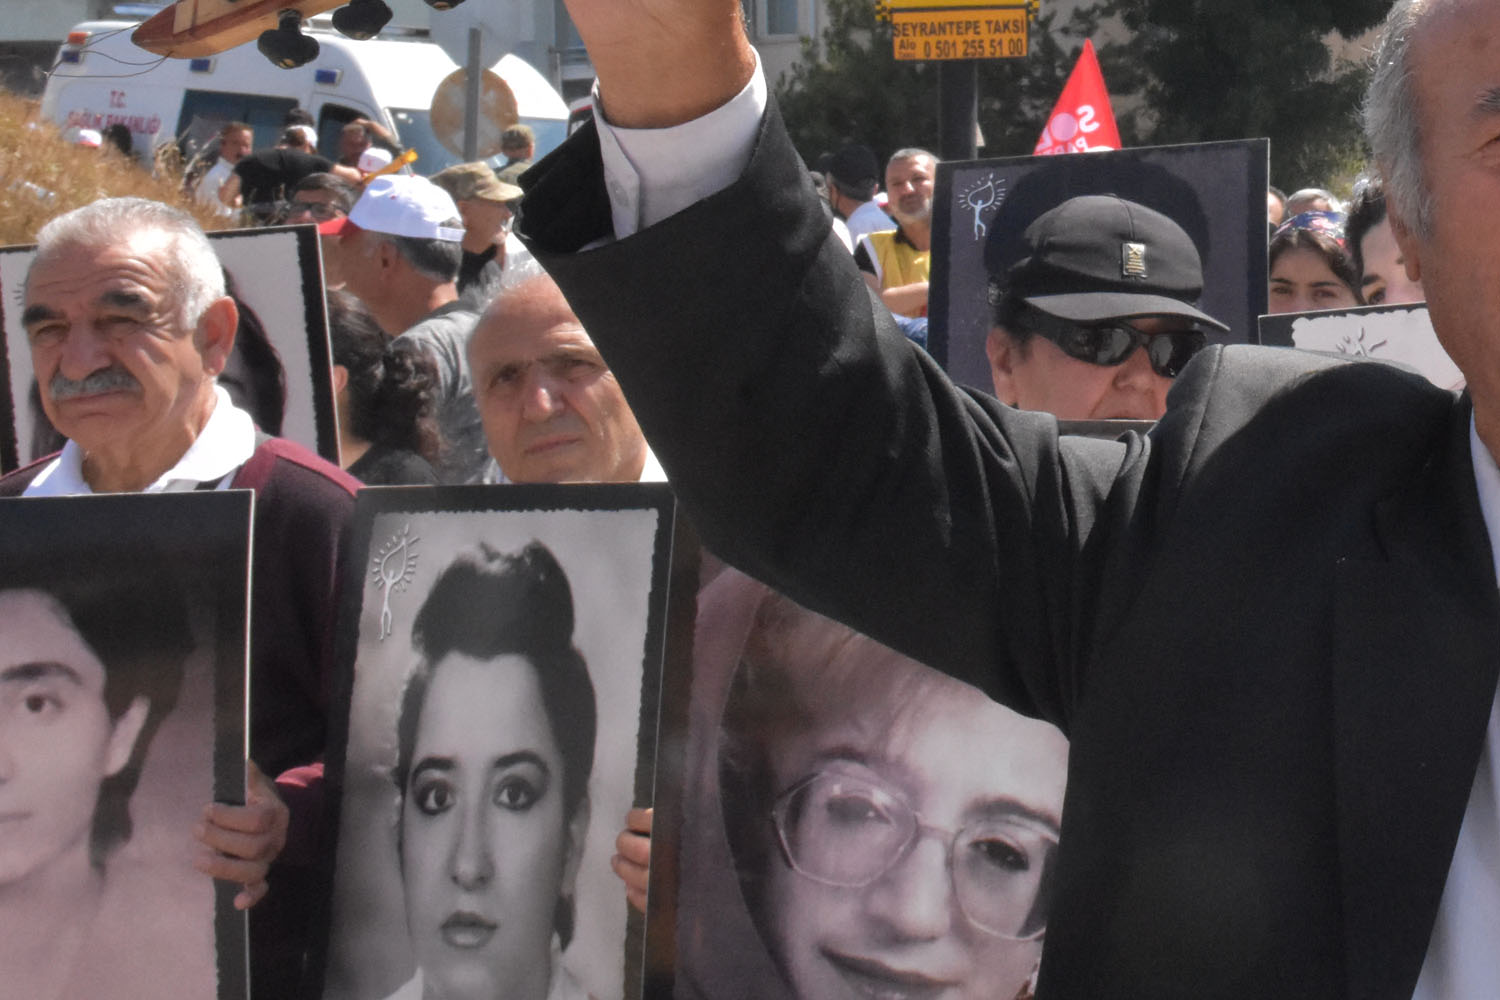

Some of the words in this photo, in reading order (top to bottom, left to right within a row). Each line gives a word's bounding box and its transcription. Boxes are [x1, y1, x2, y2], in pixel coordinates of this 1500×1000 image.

[893, 21, 982, 37] SEYRANTEPE
[985, 16, 1025, 34] TAKSİ
[924, 41, 931, 58] 0
[935, 40, 957, 58] 501
[962, 39, 985, 57] 255
[1008, 37, 1023, 55] 00
